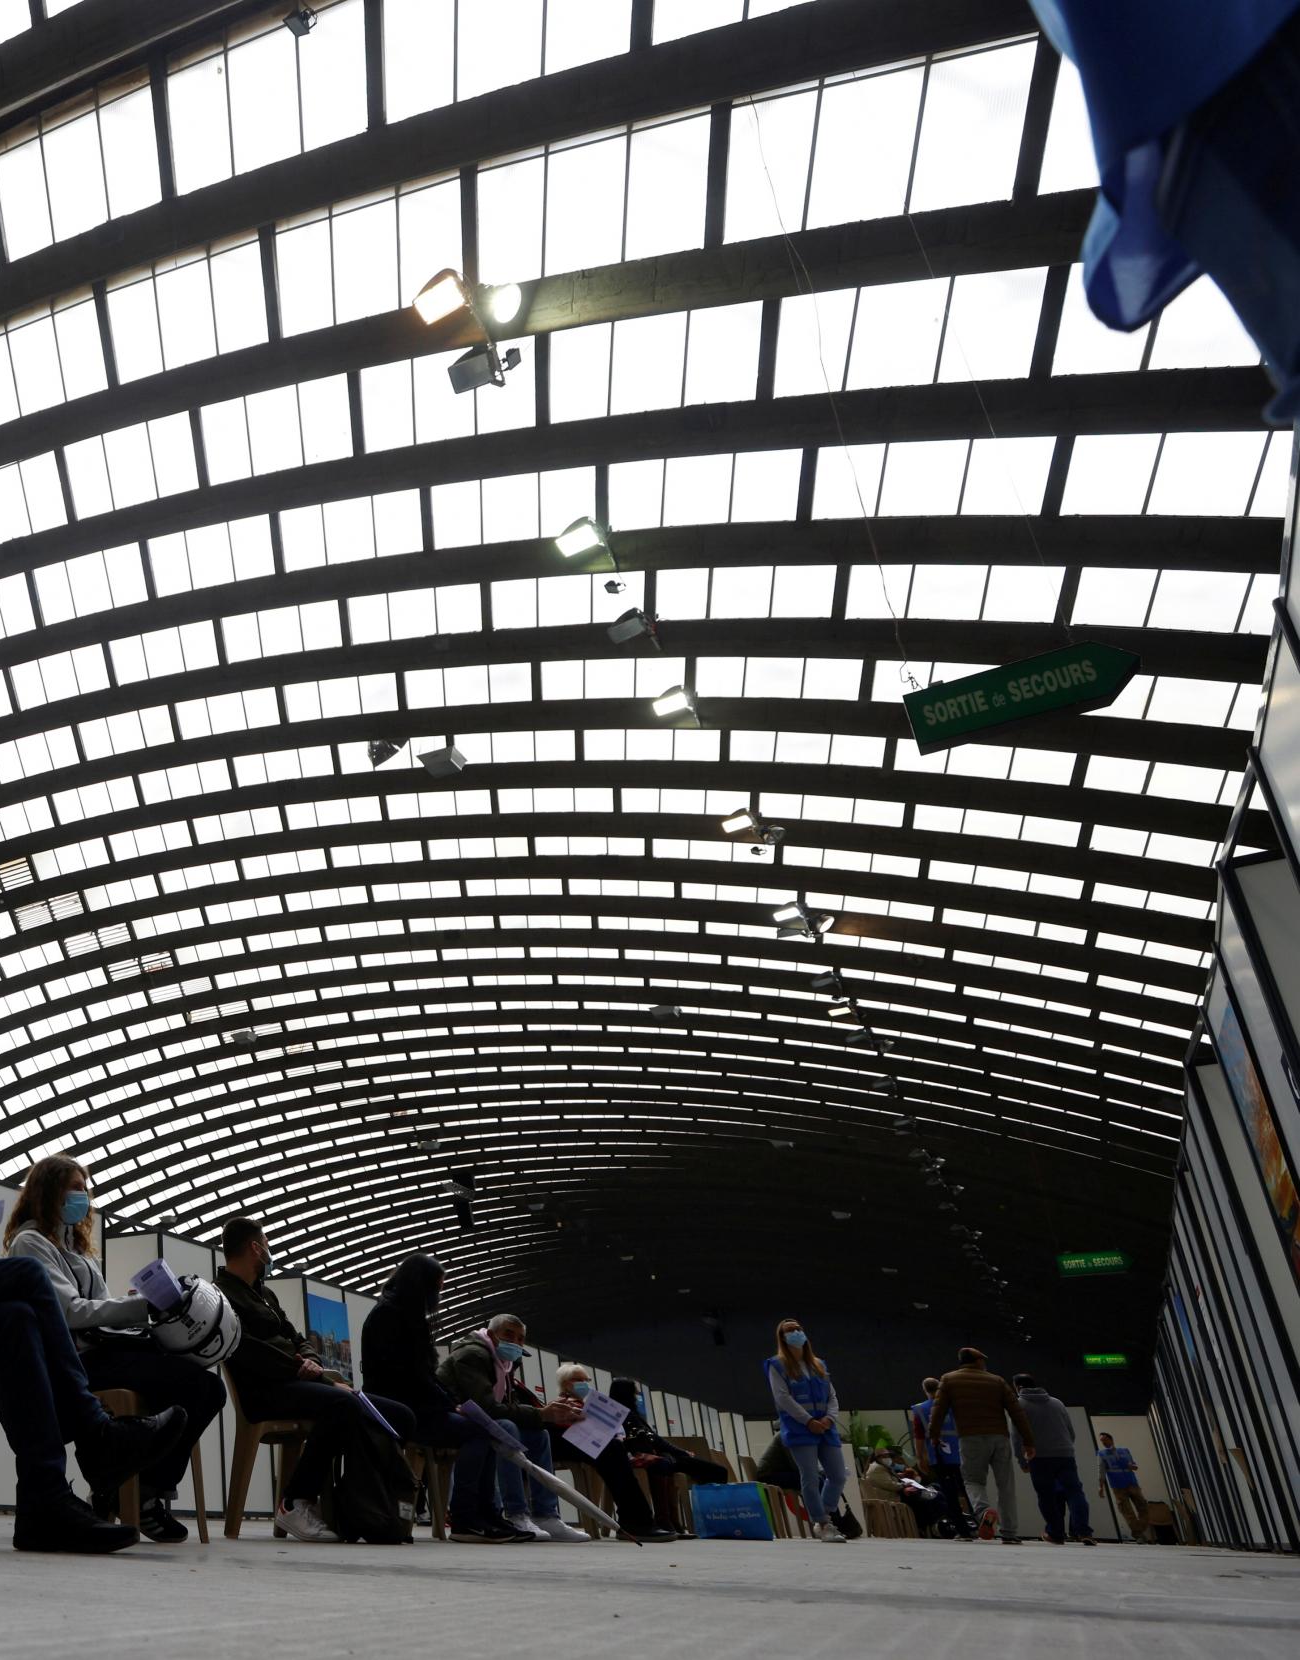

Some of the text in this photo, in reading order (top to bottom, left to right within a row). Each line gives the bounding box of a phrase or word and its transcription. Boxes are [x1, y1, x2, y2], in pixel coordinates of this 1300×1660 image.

[923, 660, 1097, 726] SORTIE de SECOURS
[1093, 1256, 1124, 1266] SECOURS
